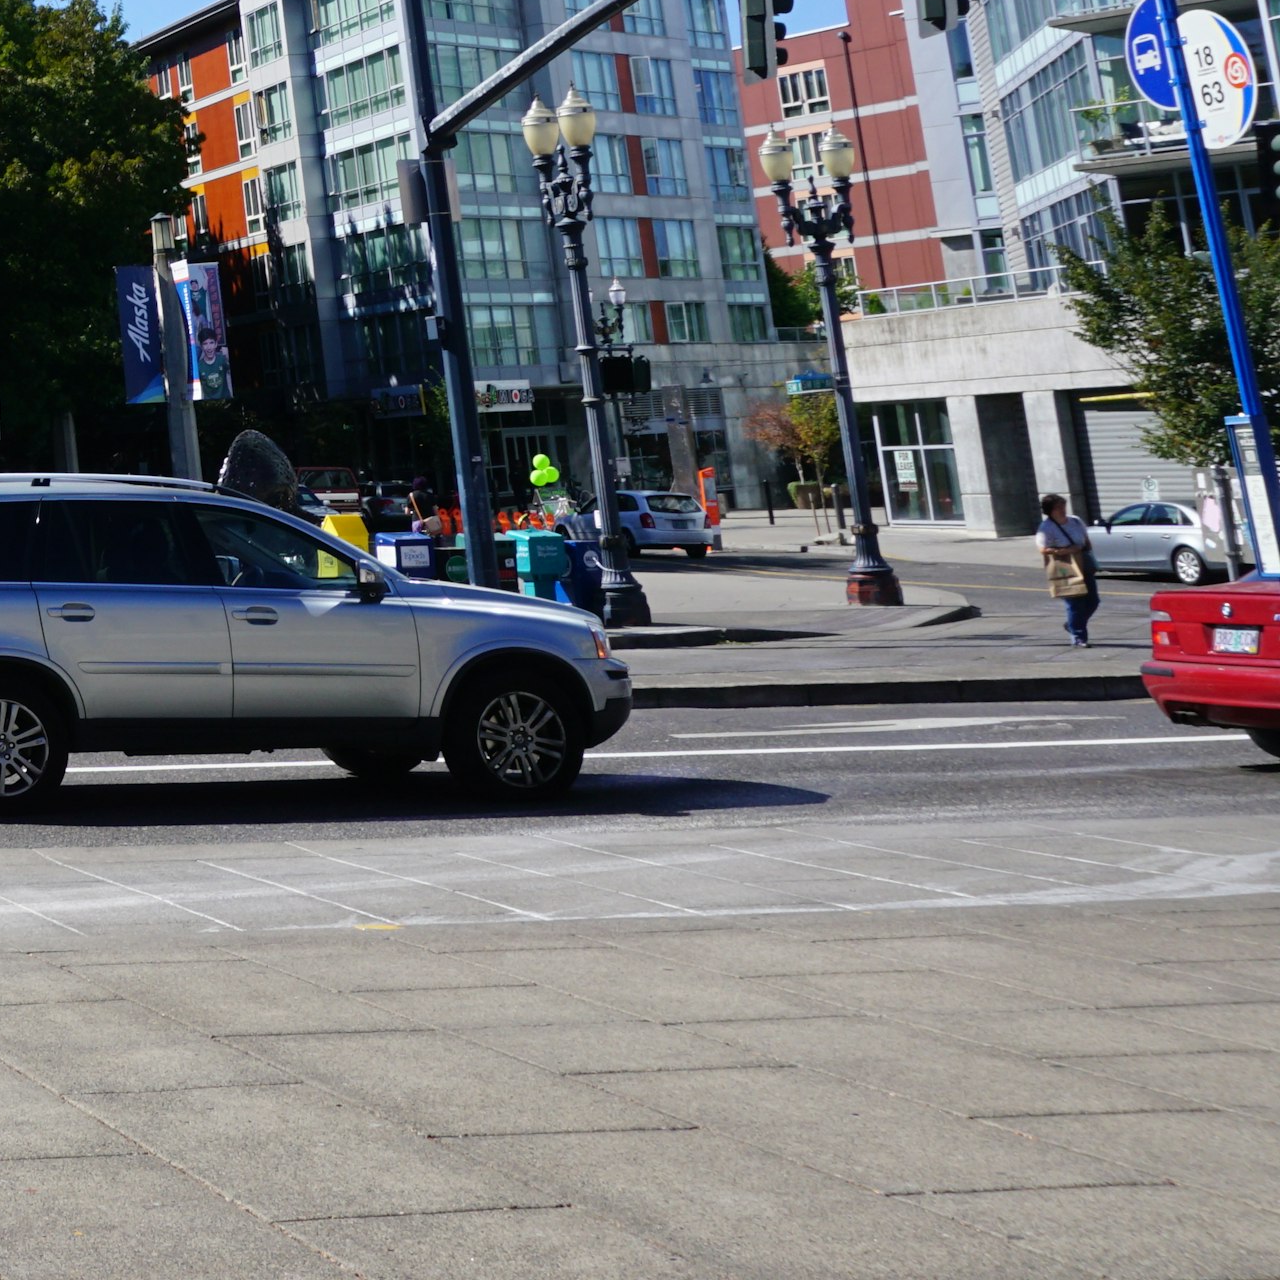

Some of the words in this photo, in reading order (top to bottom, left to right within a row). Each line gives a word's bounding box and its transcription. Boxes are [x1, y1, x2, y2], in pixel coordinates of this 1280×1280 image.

[1194, 46, 1214, 68] 18
[1201, 81, 1225, 106] 63
[126, 282, 151, 362] Alaska
[403, 551, 426, 561] Epoch
